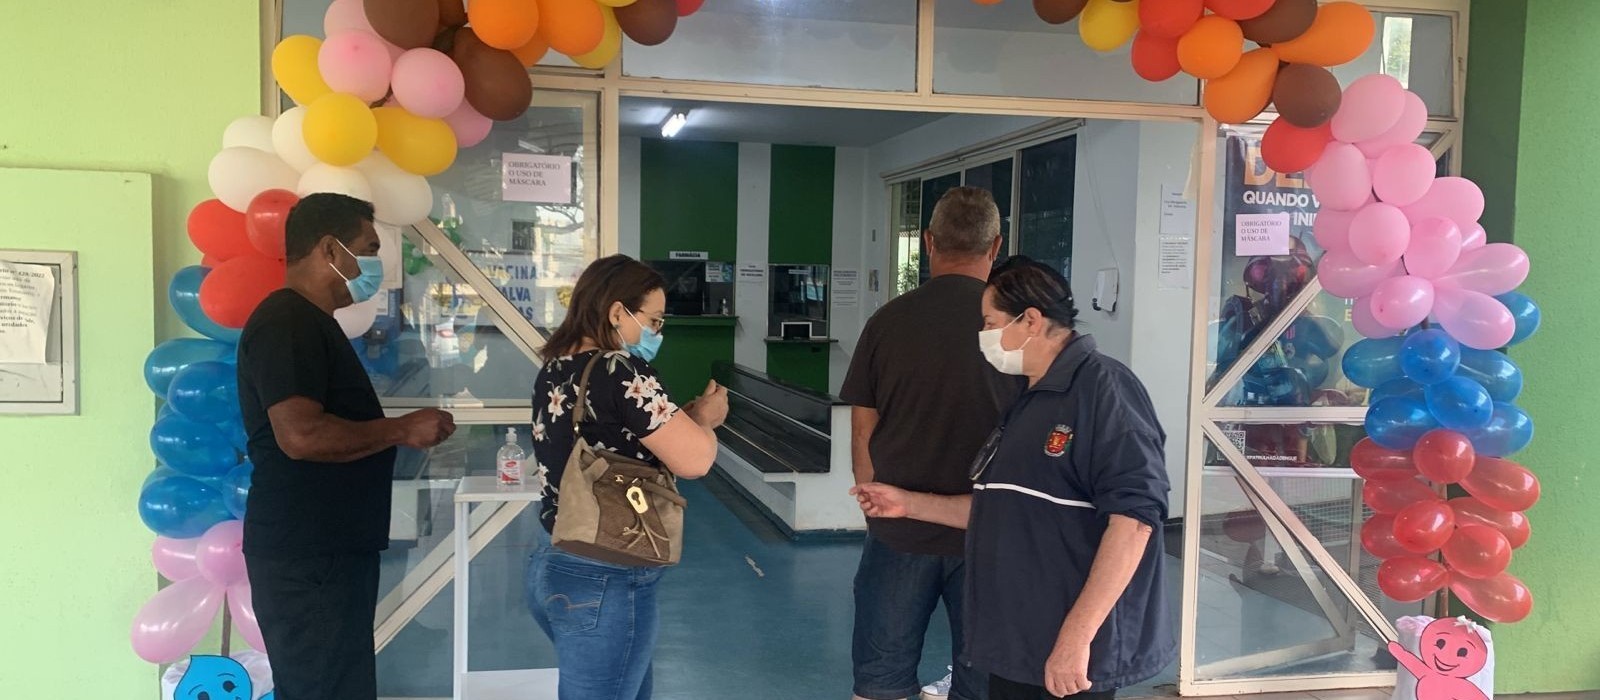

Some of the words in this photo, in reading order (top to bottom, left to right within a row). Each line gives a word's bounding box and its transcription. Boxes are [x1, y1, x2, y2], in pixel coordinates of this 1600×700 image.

[508, 161, 560, 170] OBRIGATÓRIO
[1243, 190, 1309, 207] QUANDO
[1311, 194, 1320, 208] V
[1293, 212, 1317, 226] INI
[497, 286, 531, 302] ALVA
